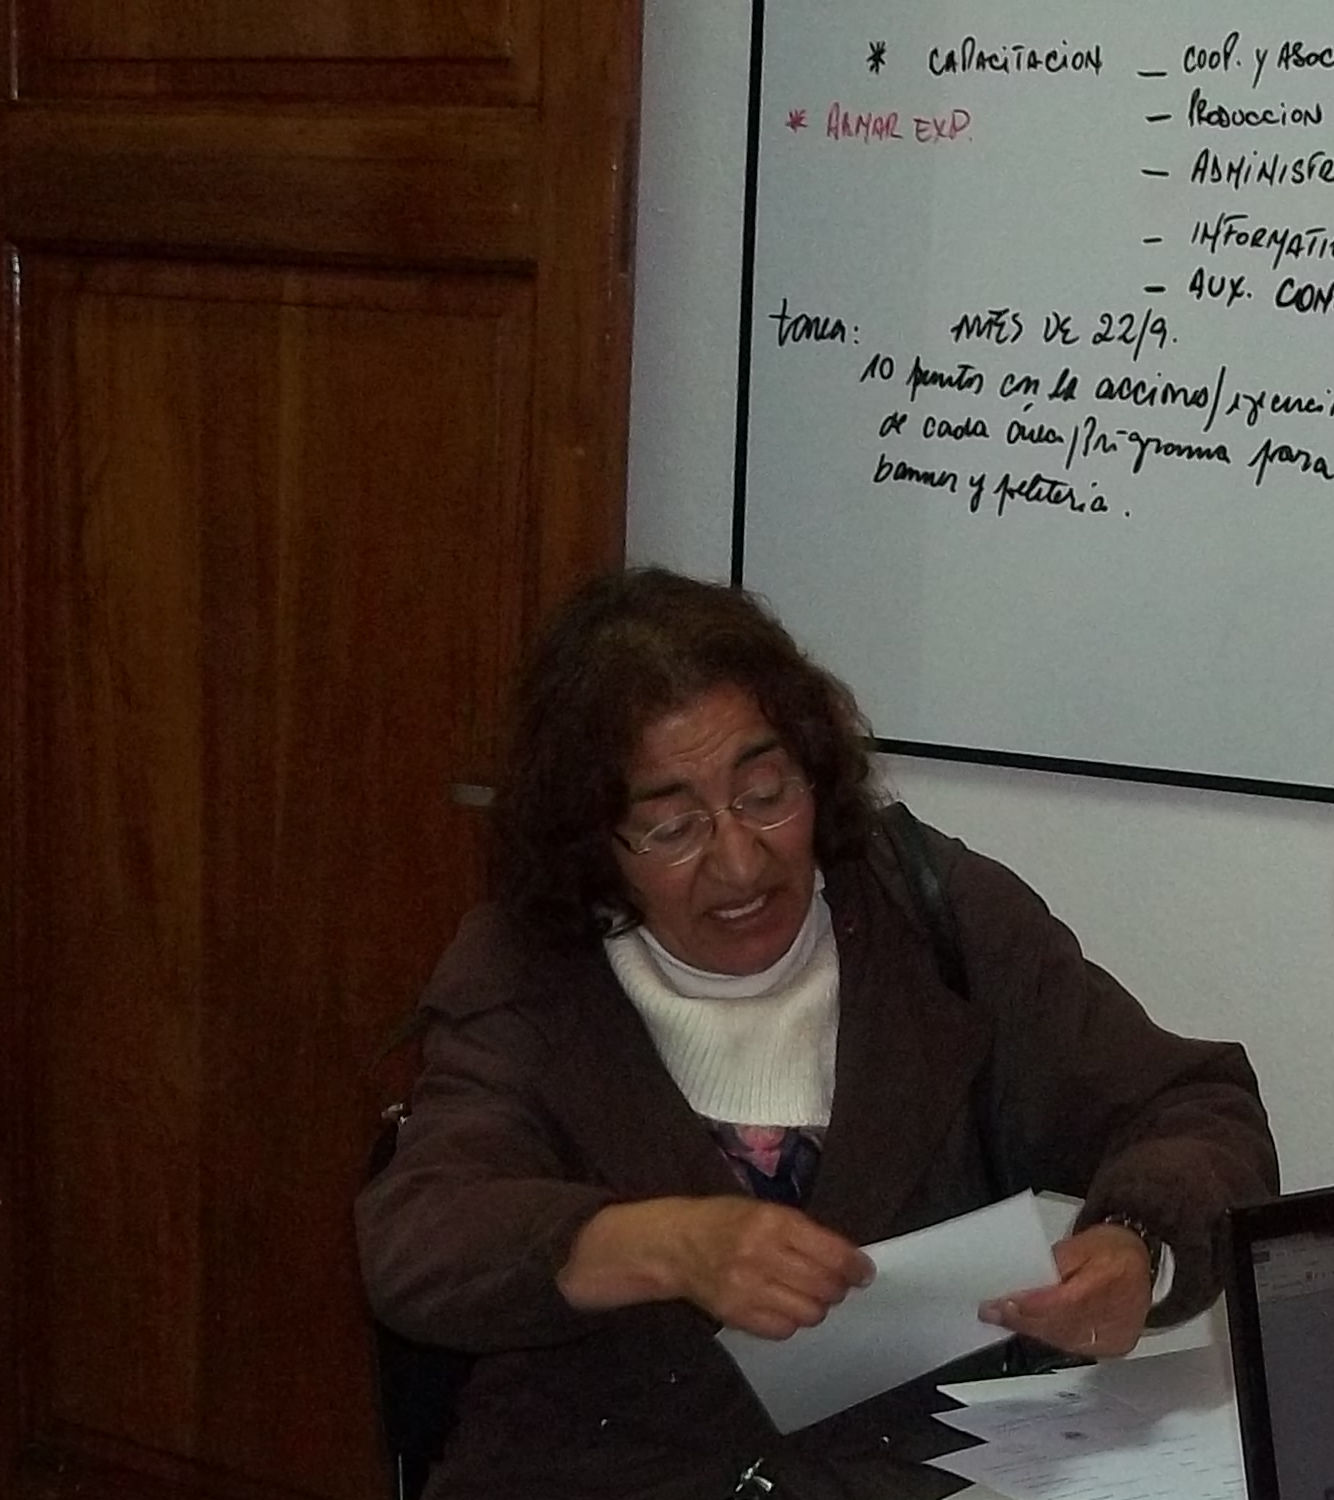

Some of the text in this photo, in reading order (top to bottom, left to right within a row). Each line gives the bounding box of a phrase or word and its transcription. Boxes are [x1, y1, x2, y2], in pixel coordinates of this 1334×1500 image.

[928, 36, 1103, 77] CAPACITACION
[1183, 30, 1242, 74] COOP.
[1187, 91, 1323, 129] PRODUCCION
[1188, 267, 1253, 305] AUX.
[1042, 311, 1080, 346] DE
[859, 352, 895, 383] 10
[922, 415, 990, 441] cada
[968, 473, 987, 503] y
